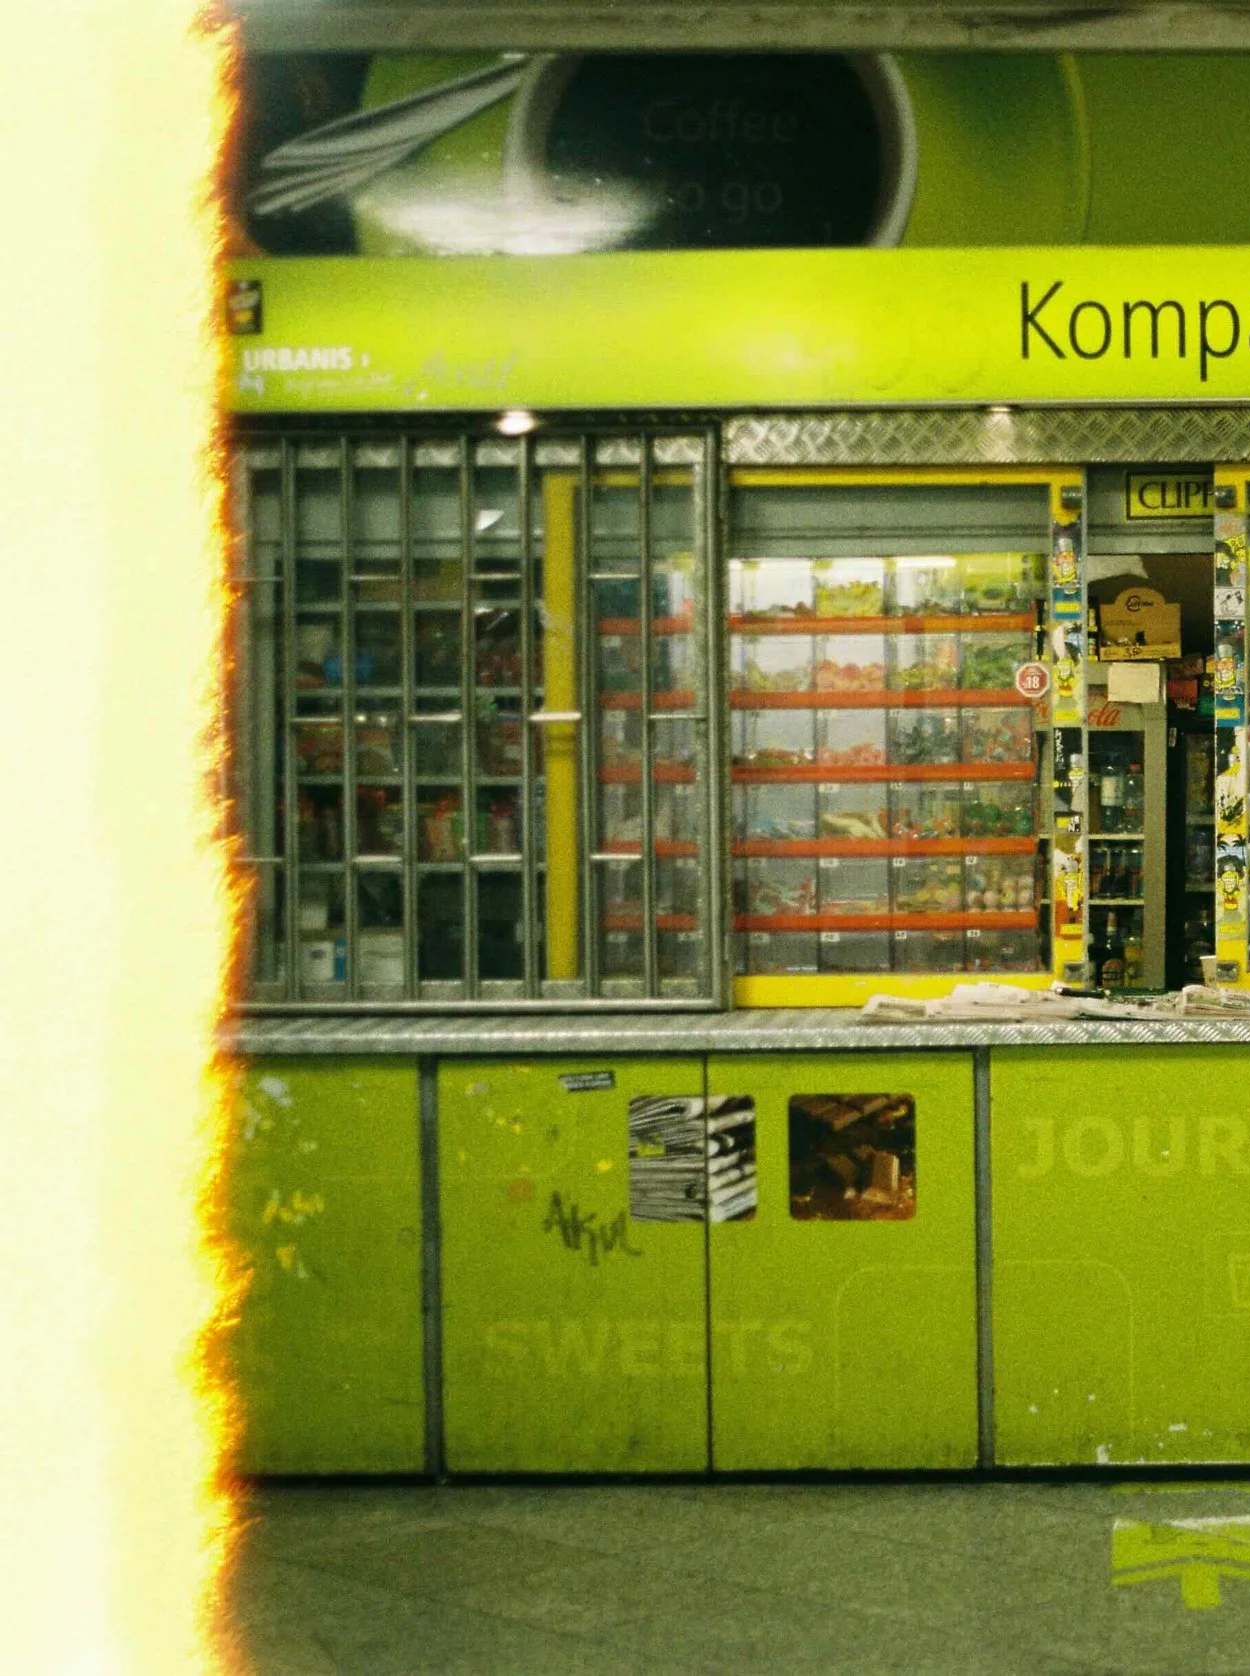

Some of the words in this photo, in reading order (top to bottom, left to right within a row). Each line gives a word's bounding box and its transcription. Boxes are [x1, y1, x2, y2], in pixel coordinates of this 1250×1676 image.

[643, 99, 798, 143] Coffee
[721, 181, 783, 225] go
[242, 346, 353, 371] URBANIS
[1026, 675, 1040, 689] 18
[483, 1316, 815, 1377] SWEETS
